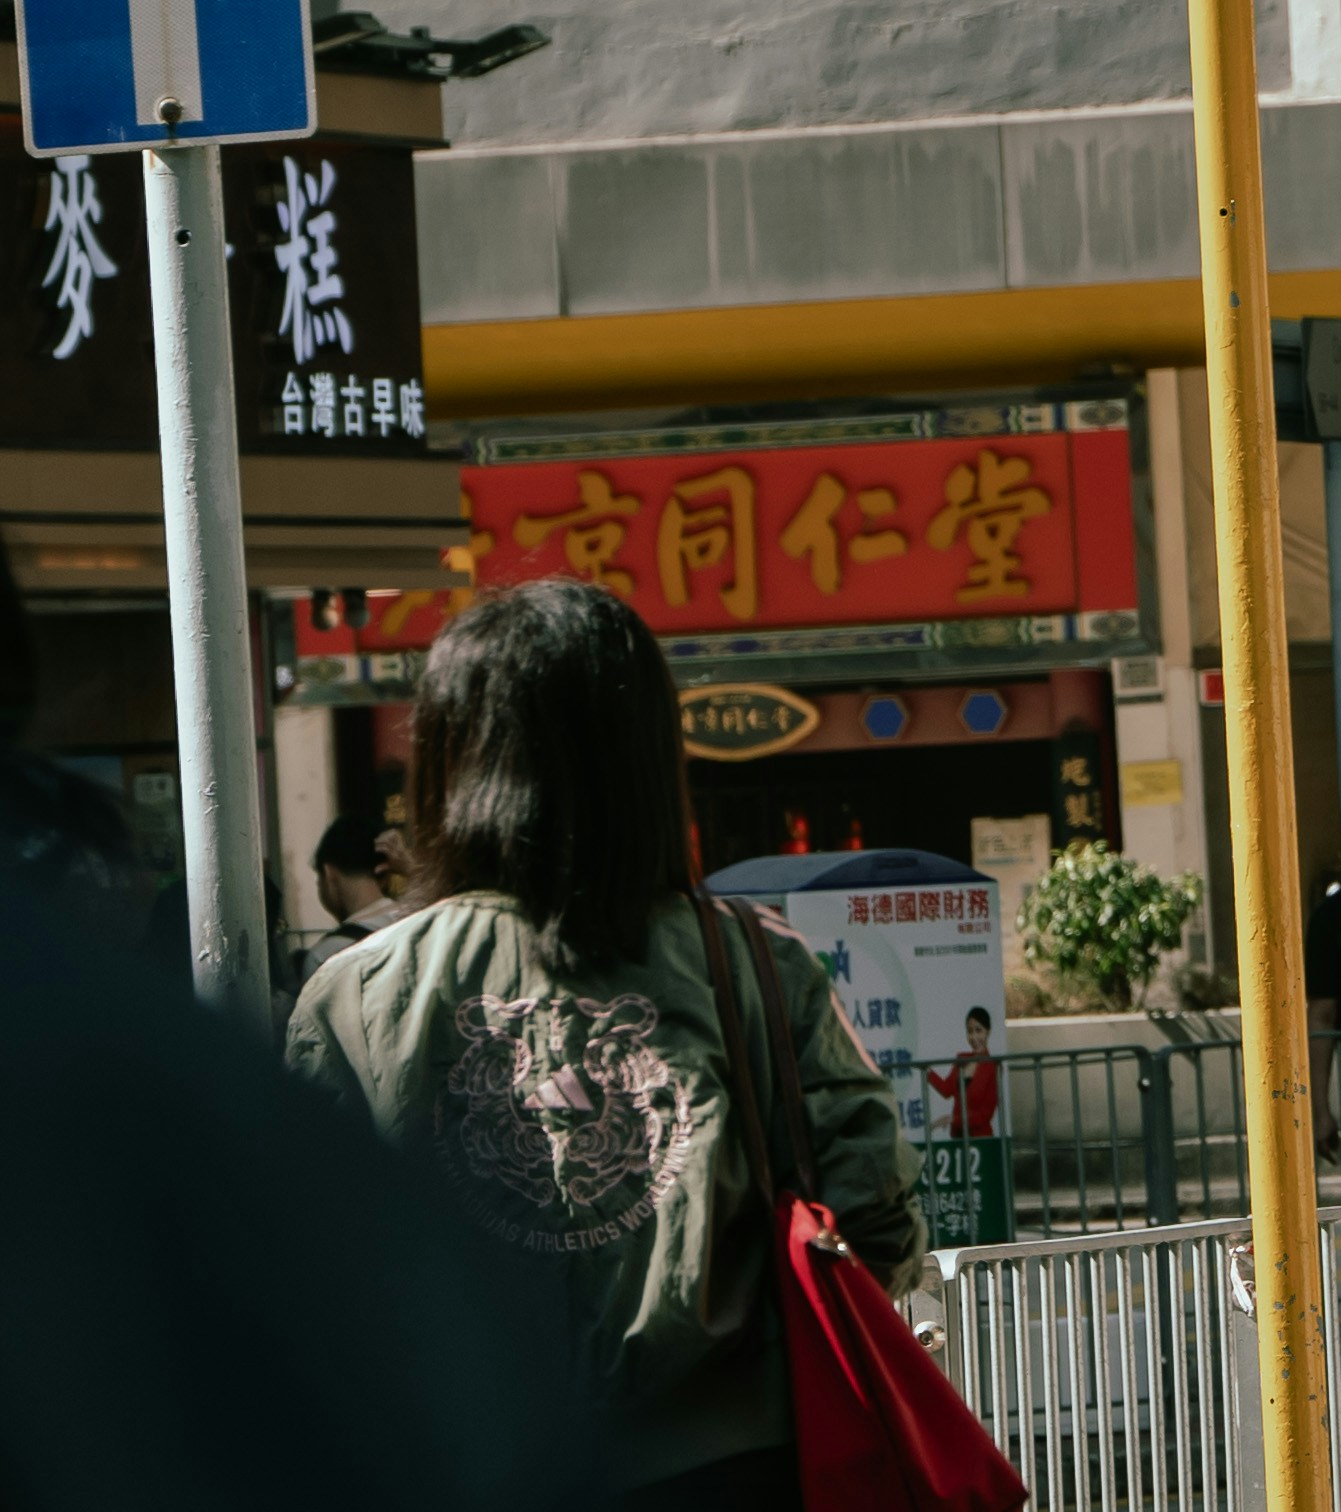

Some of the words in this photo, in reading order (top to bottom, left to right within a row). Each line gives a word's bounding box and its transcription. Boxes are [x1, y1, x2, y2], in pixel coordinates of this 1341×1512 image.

[281, 372, 425, 438] 台灣古早味
[523, 1219, 622, 1253] ATHLETICS
